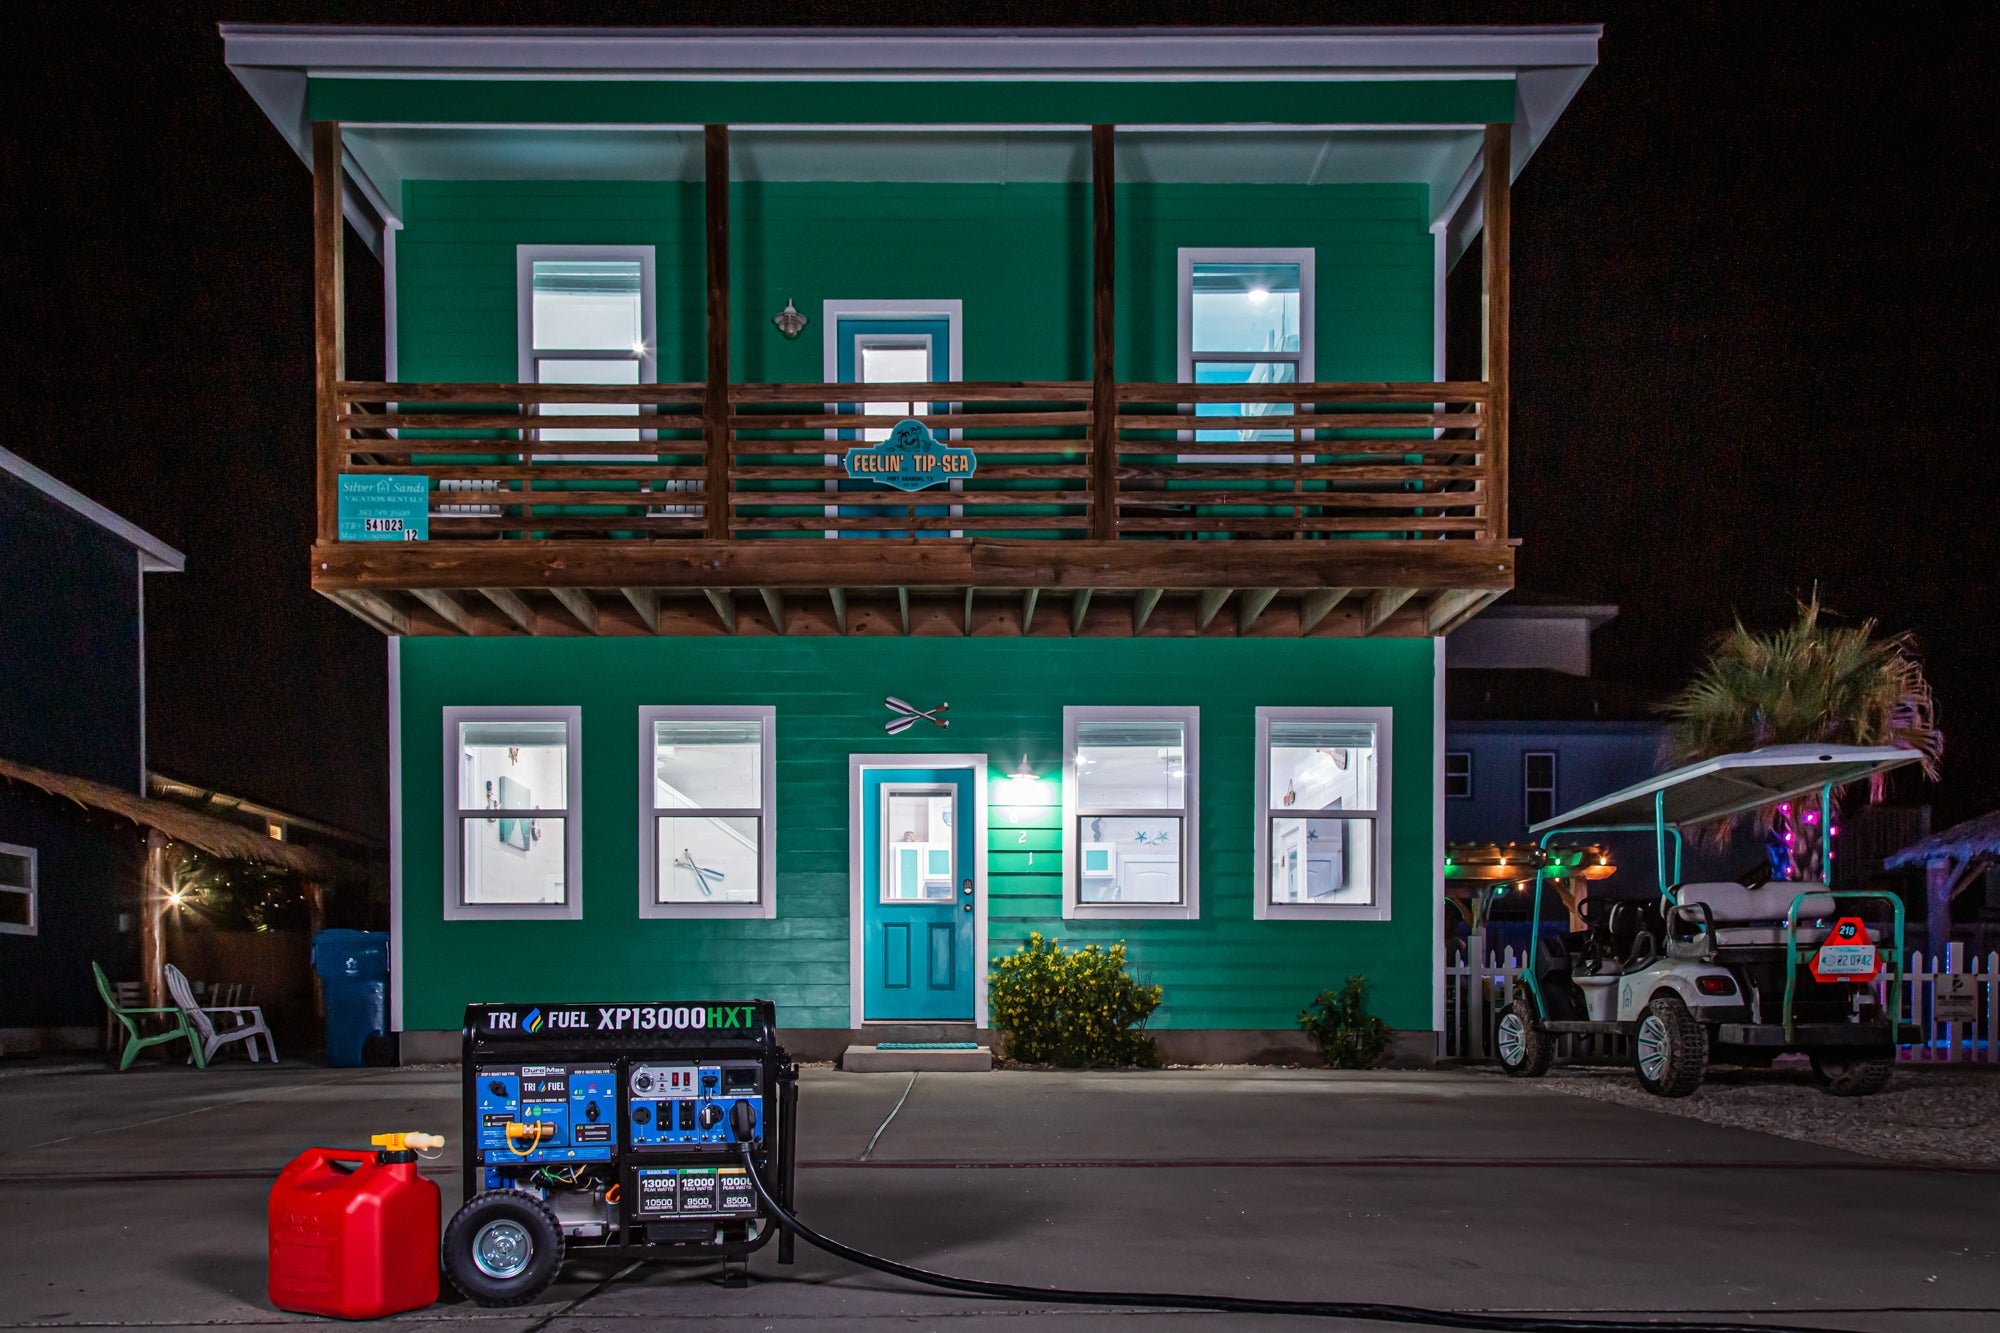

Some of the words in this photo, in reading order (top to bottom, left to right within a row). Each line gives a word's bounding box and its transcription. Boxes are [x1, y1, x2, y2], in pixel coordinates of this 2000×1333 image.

[853, 454, 904, 472] FEELIN'
[913, 454, 969, 472] TIP-SEA
[342, 482, 375, 492] Silver
[393, 482, 425, 492] Sands
[366, 519, 403, 530] 541023
[406, 530, 418, 540] 12
[1839, 925, 1854, 936] 218
[488, 1012, 516, 1030] TRI
[548, 1011, 590, 1028] FUEL
[597, 1006, 756, 1030] XP13000HXT
[523, 1082, 536, 1092] TRI
[548, 1082, 565, 1091] FUEL
[642, 1179, 676, 1188] 13000
[681, 1178, 714, 1187] 12000
